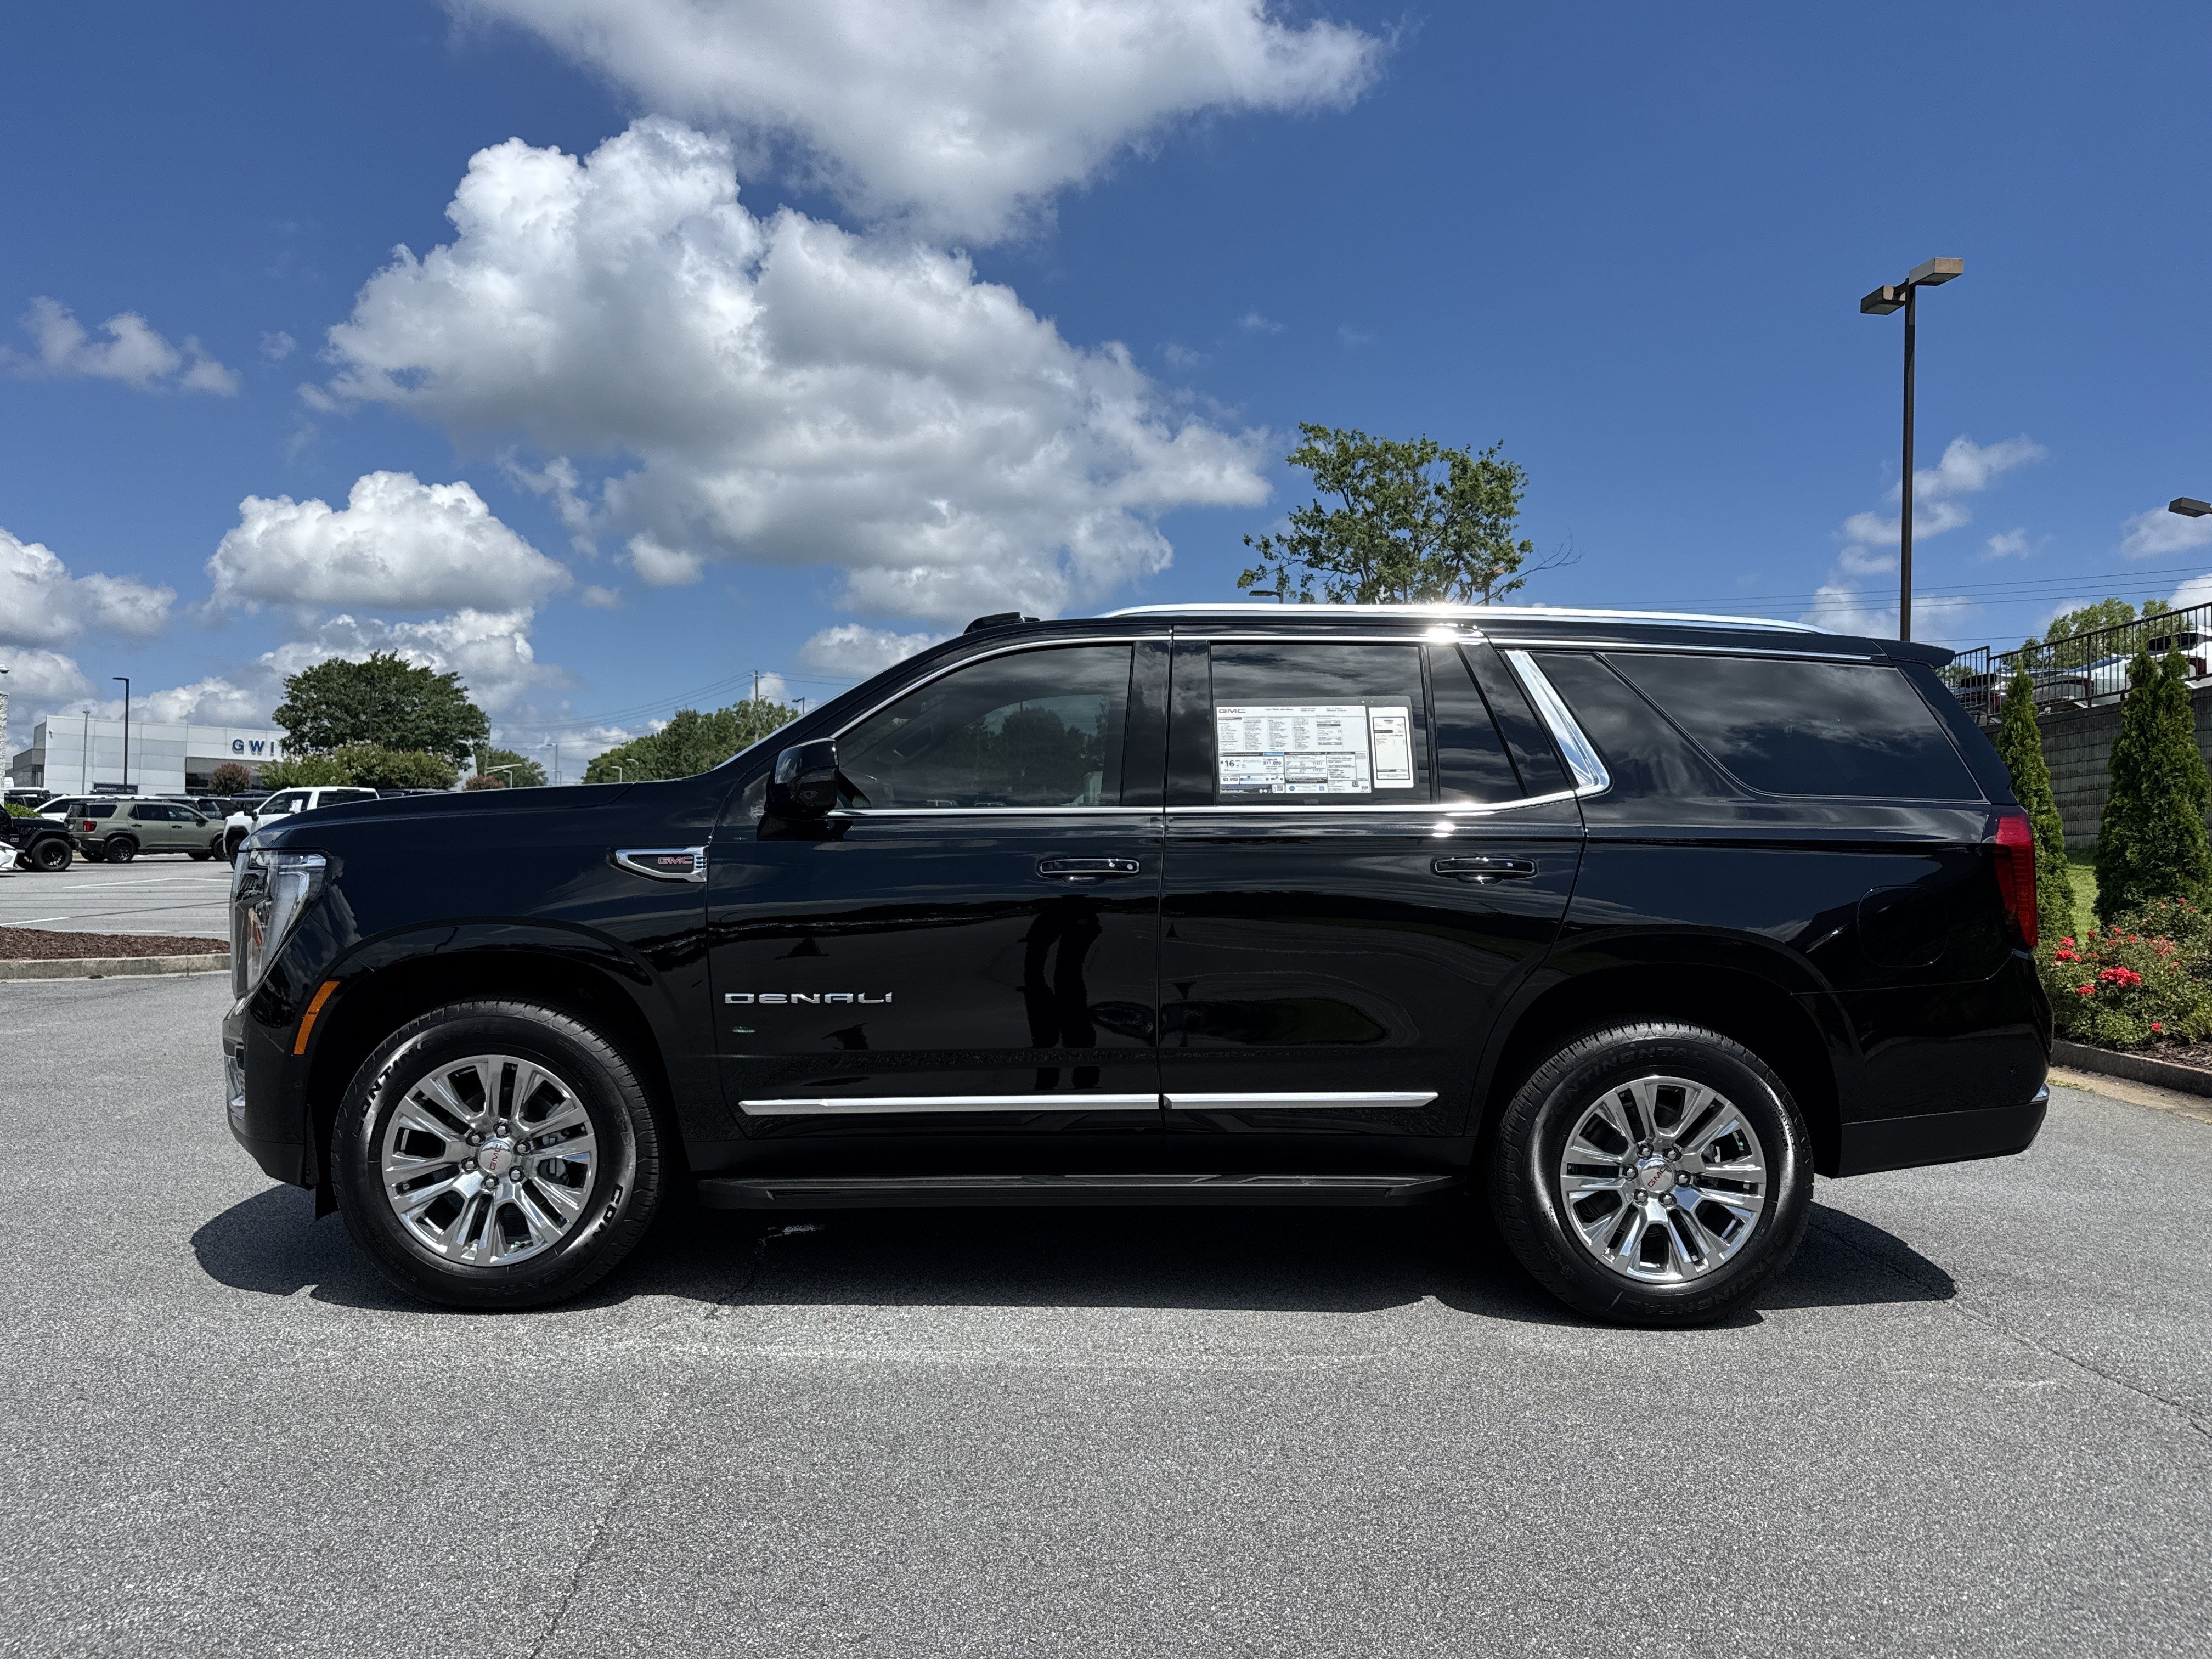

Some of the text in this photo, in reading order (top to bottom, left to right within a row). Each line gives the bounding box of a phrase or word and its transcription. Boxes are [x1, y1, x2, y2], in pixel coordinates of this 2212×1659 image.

[725, 992, 893, 1003] DENALI
[489, 1144, 503, 1170] GMC
[1647, 1163, 1667, 1188] GMC
